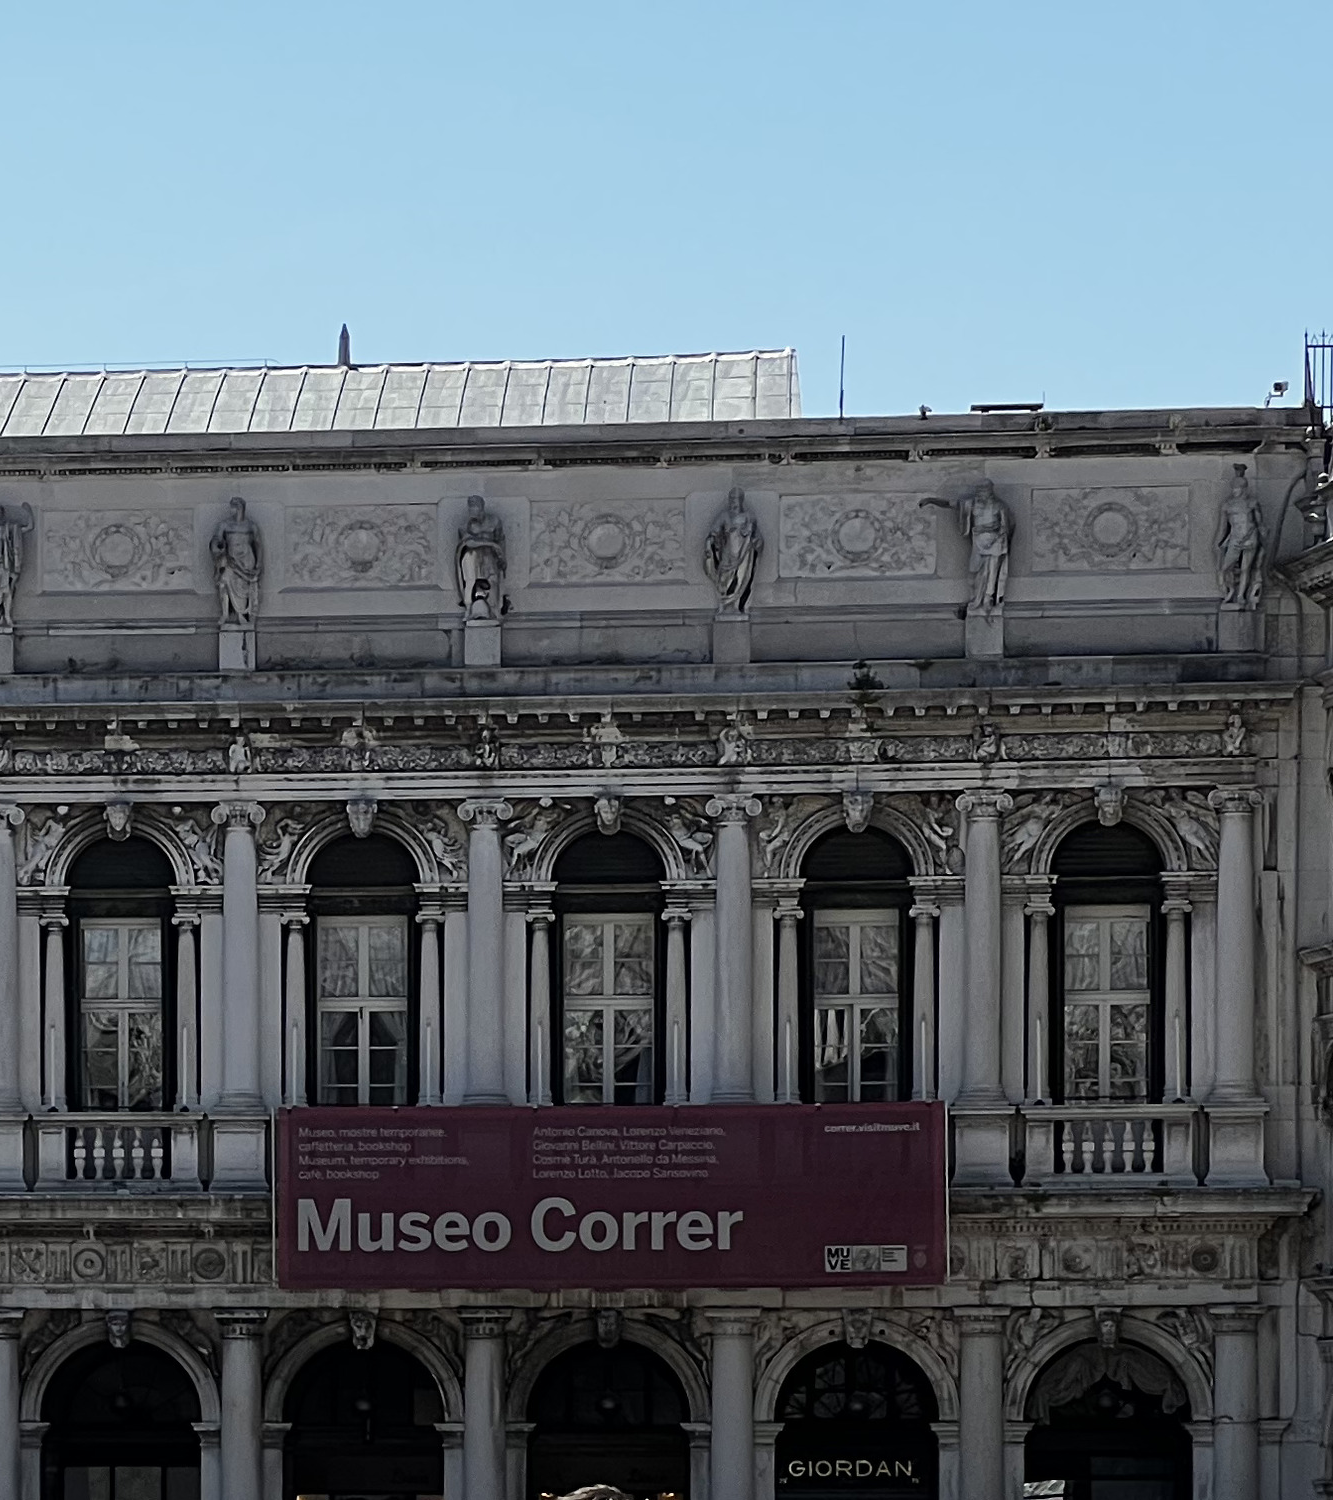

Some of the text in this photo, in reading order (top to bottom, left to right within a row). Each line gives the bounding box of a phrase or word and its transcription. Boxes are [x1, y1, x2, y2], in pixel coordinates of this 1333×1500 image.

[339, 1127, 377, 1138] mostre
[533, 1126, 575, 1137] Antonio
[623, 1126, 667, 1137] Lorenzo
[358, 1141, 412, 1153] bookshop
[533, 1139, 579, 1150] Giovanni
[619, 1139, 656, 1150] Vittore
[350, 1155, 408, 1167] temporary
[601, 1153, 653, 1164] Antonello
[655, 1153, 669, 1164] da
[326, 1168, 379, 1181] bookshop
[533, 1167, 576, 1178] Lorenzo
[612, 1167, 651, 1180] Jacopo
[653, 1167, 709, 1178] Sansovino
[296, 1196, 744, 1253] Museo Correr
[788, 1459, 912, 1478] GIORDAN
